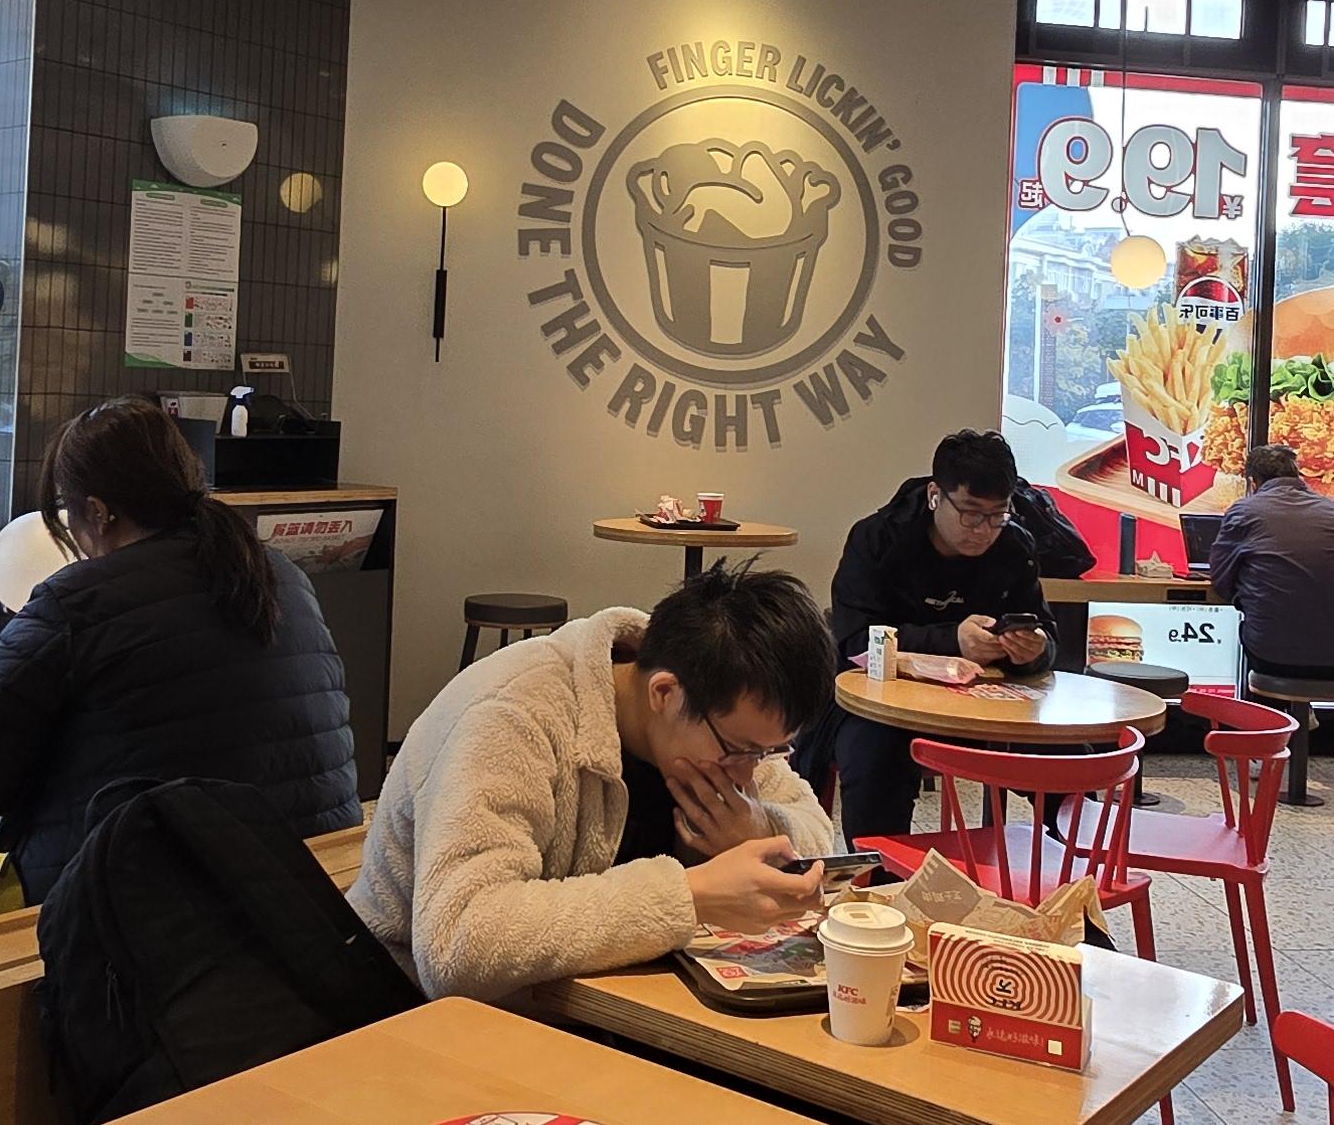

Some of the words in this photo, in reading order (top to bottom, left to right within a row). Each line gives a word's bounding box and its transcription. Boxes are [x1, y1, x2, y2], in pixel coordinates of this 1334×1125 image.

[518, 99, 606, 257] DONE
[647, 40, 781, 89] FINGER
[878, 163, 923, 269] GOOD
[527, 269, 623, 389] THE
[793, 315, 906, 429] WAY
[607, 363, 781, 451] RIGHT
[837, 984, 859, 996] KFC
